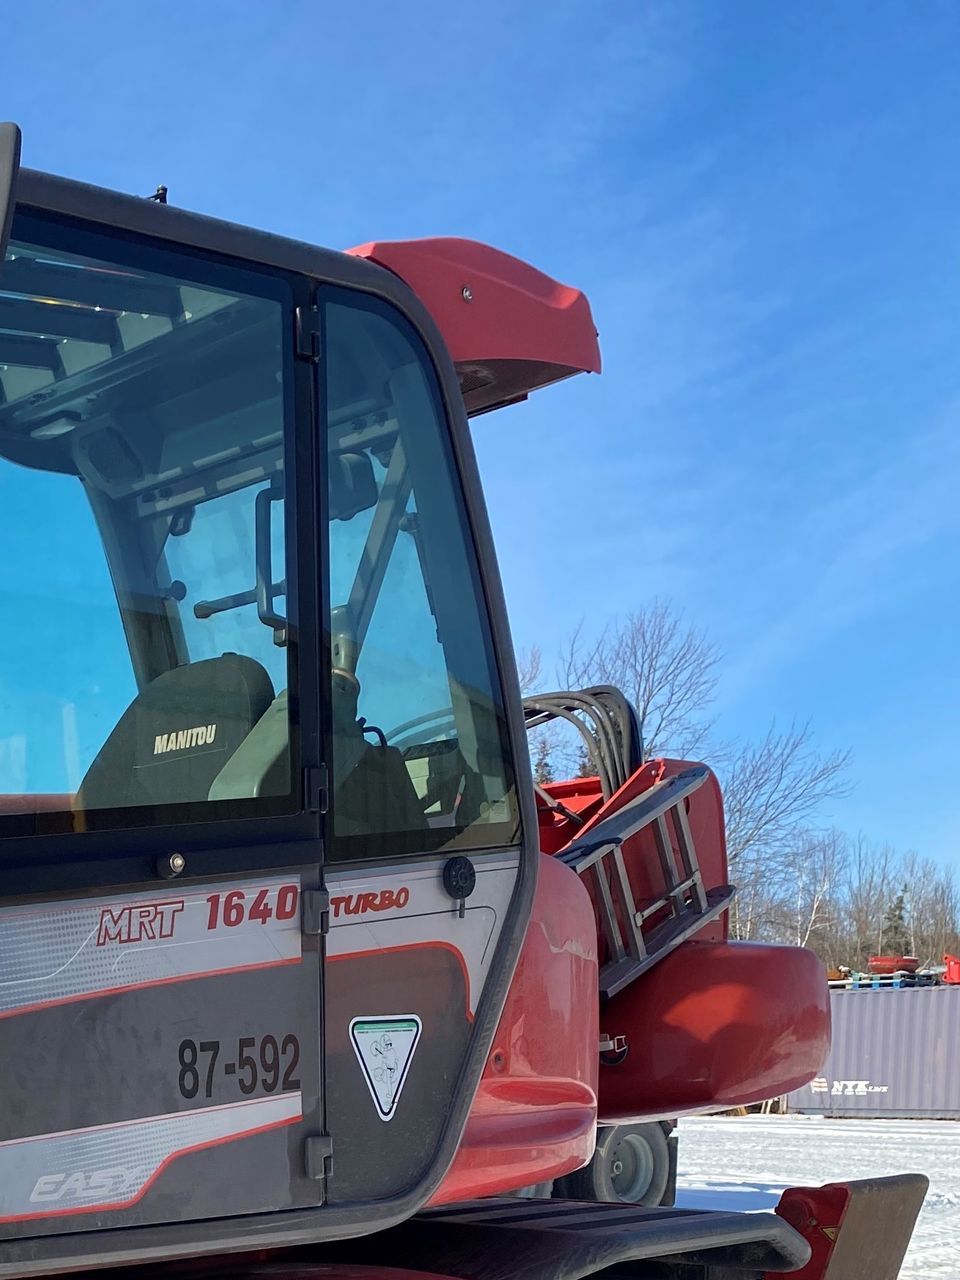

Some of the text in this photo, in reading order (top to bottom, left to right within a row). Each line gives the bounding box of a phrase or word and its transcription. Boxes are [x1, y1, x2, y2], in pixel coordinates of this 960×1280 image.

[153, 724, 217, 755] MANITOU
[96, 885, 409, 946] MRT 1640 TURBO
[178, 1033, 301, 1100] 87-592
[29, 1166, 144, 1203] EASY
